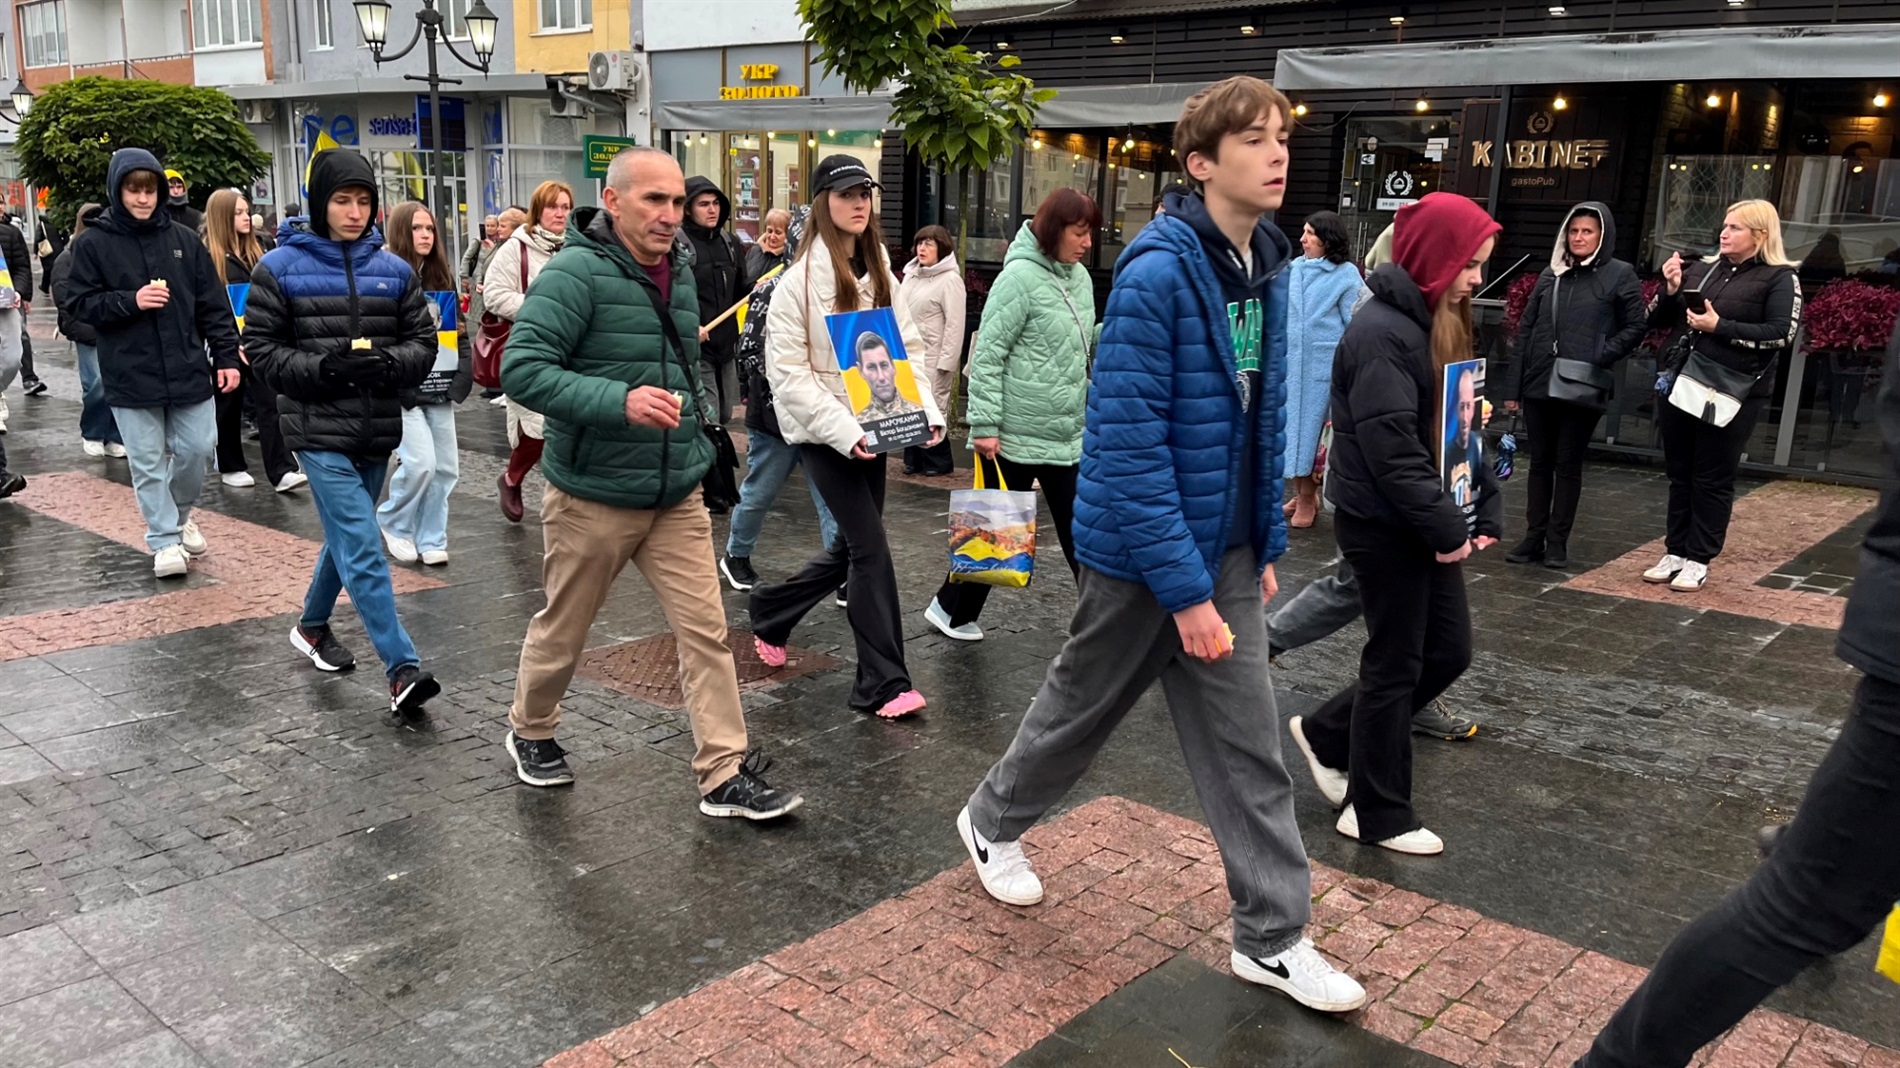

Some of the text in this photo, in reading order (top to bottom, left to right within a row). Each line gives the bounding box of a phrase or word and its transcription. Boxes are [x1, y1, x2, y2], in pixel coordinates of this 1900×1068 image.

[739, 63, 779, 80] УКР
[719, 84, 801, 100] ЗОЛОТО
[602, 145, 620, 153] УКР
[593, 152, 616, 160] ЗОЛ
[1511, 176, 1555, 187] gastoPub
